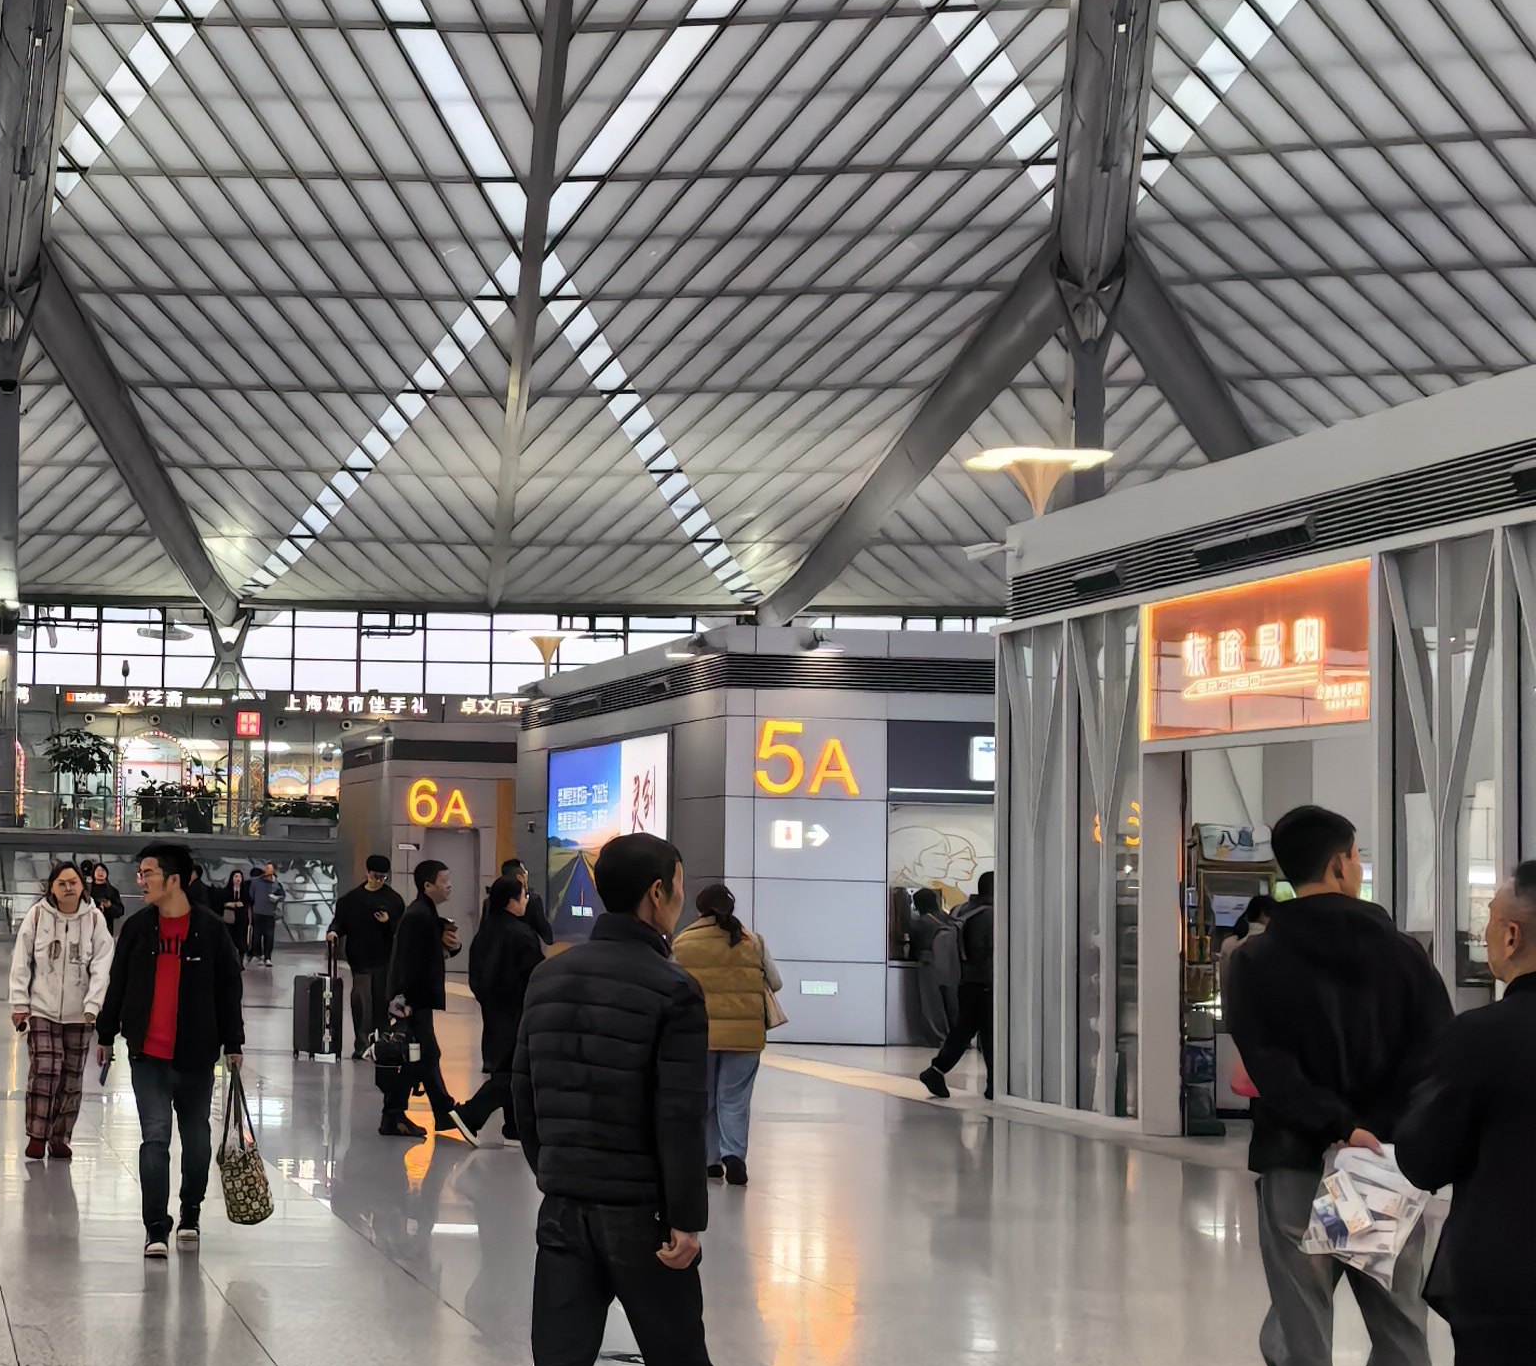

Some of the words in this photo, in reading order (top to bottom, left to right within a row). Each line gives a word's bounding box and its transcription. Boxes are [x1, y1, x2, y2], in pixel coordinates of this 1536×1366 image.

[1185, 616, 1322, 677] 旅途易购
[285, 693, 429, 714] 上海城市伴手礼
[754, 720, 859, 796] 5A
[407, 778, 472, 826] 6A
